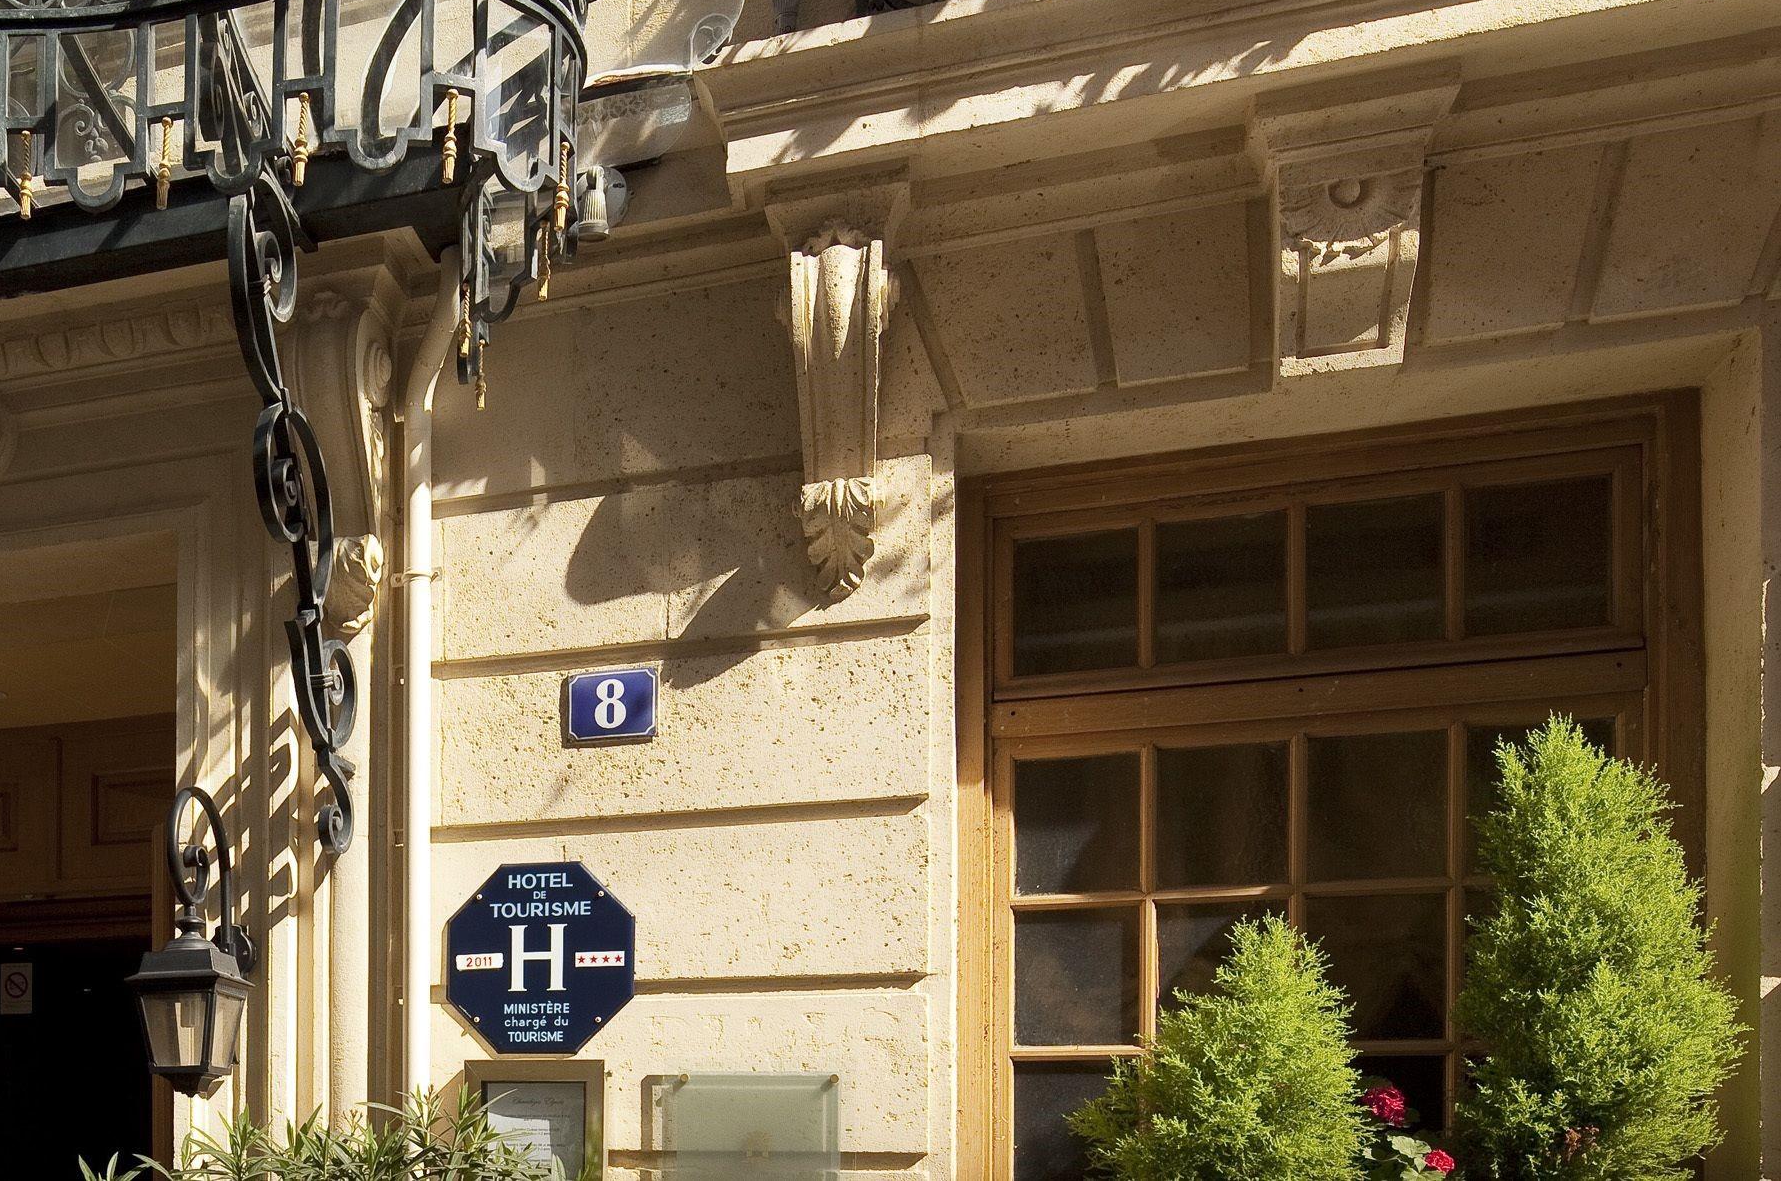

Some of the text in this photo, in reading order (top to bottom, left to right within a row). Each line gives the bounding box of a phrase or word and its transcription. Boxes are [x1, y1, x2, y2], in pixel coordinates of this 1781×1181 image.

[594, 678, 627, 729] 8
[507, 872, 574, 889] HOTEL
[533, 890, 547, 900] DE
[489, 900, 592, 919] TOURISME
[465, 956, 493, 968] 2011
[507, 923, 568, 992] H
[503, 1001, 570, 1015] MINISTÈRE
[504, 1015, 569, 1029] chargé du
[507, 1031, 564, 1043] TOURISME
